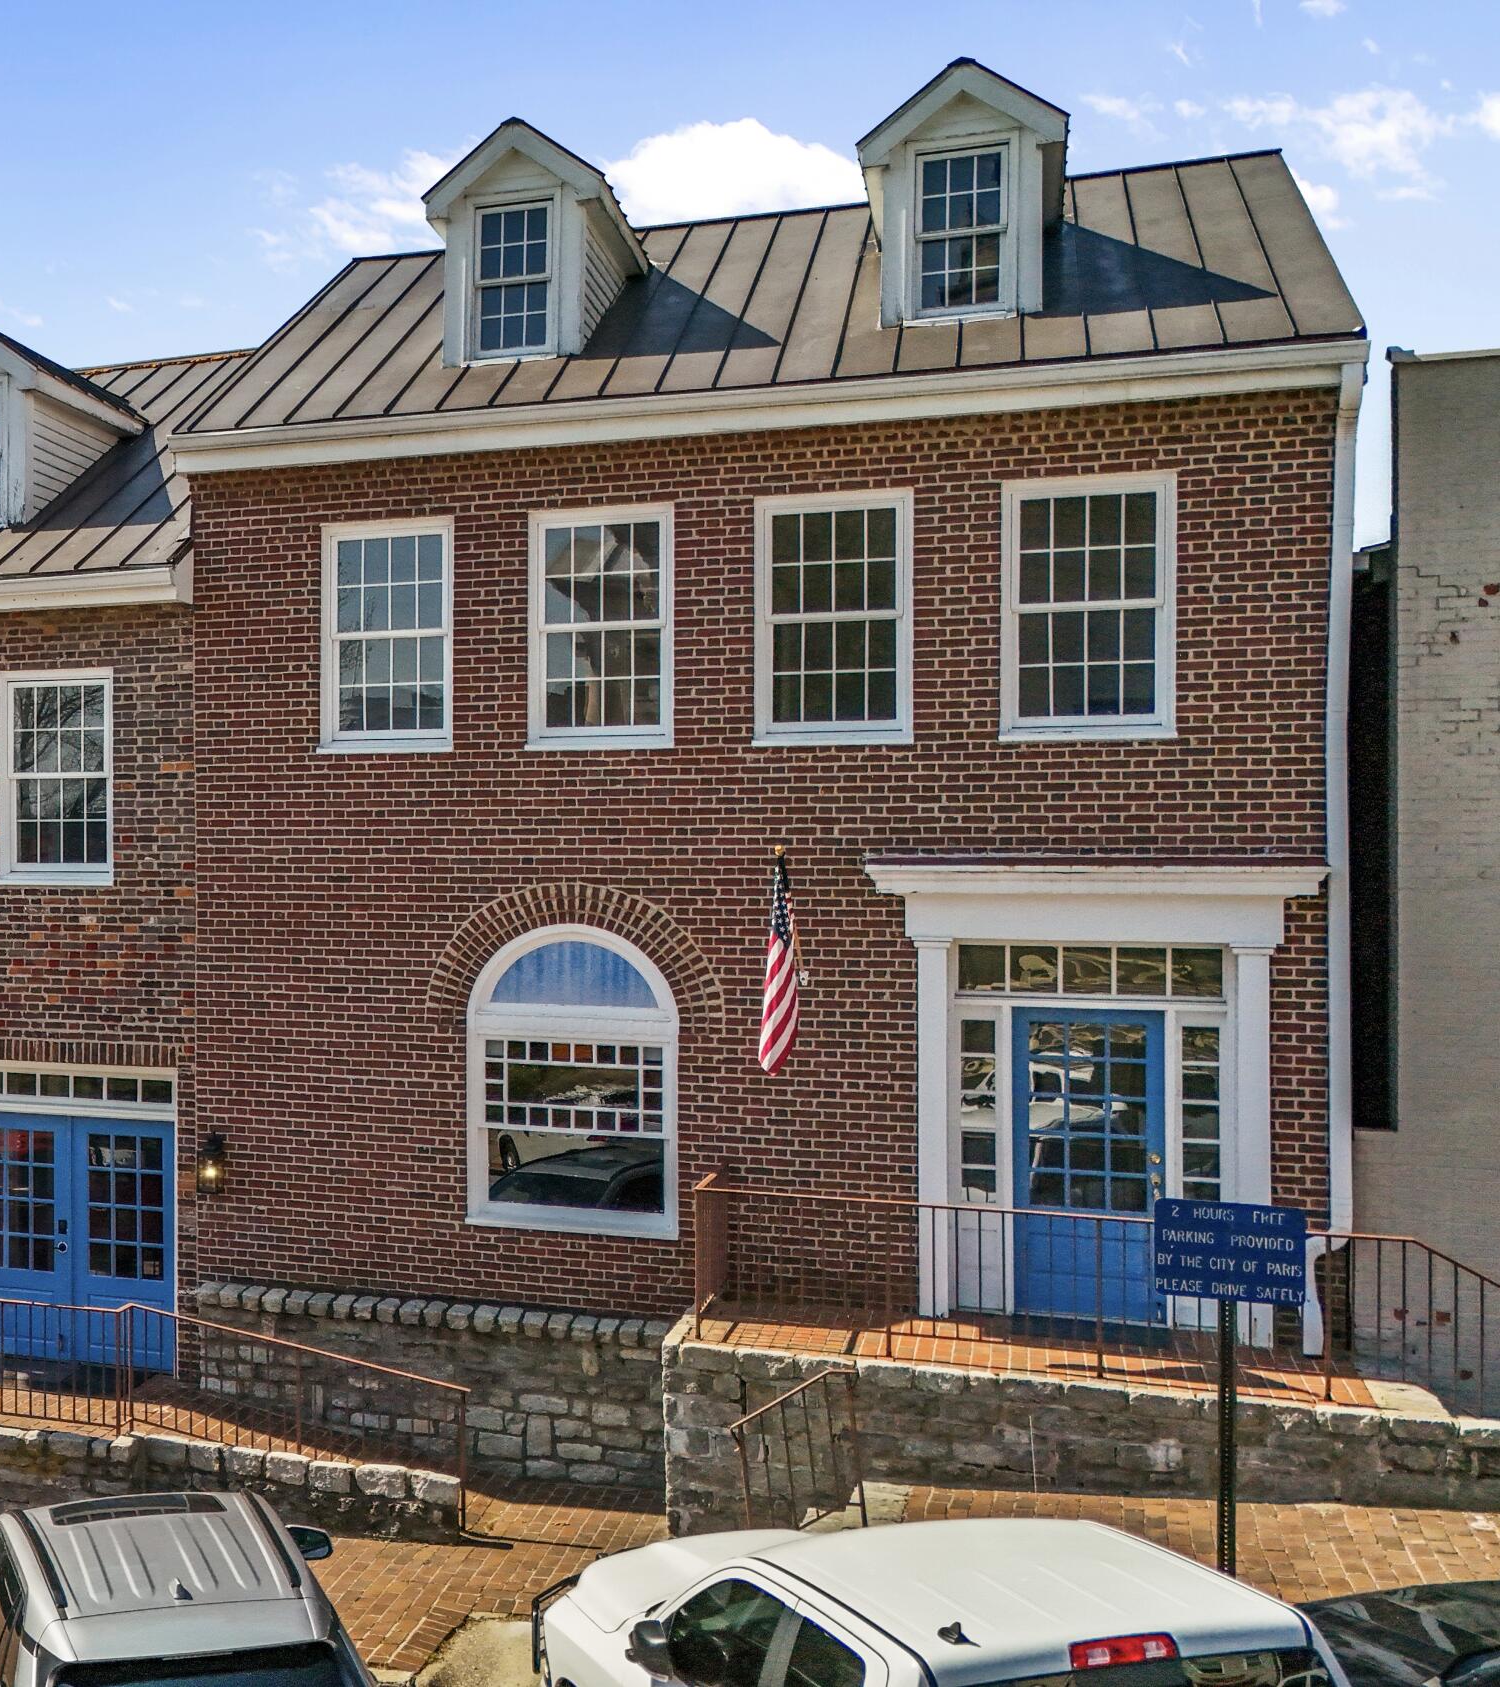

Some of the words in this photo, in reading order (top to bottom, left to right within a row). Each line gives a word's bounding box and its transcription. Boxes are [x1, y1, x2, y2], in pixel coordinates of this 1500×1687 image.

[1171, 1205, 1180, 1217] 2
[1193, 1207, 1234, 1221] HOURS
[1253, 1211, 1286, 1226] FREE
[1162, 1228, 1215, 1244] PARKING
[1230, 1235, 1294, 1251] PROVIDED
[1157, 1253, 1173, 1265] BY
[1180, 1256, 1203, 1269] THE
[1209, 1258, 1235, 1271] CITY
[1242, 1260, 1259, 1273] OF
[1266, 1263, 1303, 1277] PARIS
[1155, 1277, 1203, 1293] PLEASE
[1211, 1282, 1247, 1298] DRIVE
[1256, 1286, 1304, 1302] SAFELY
